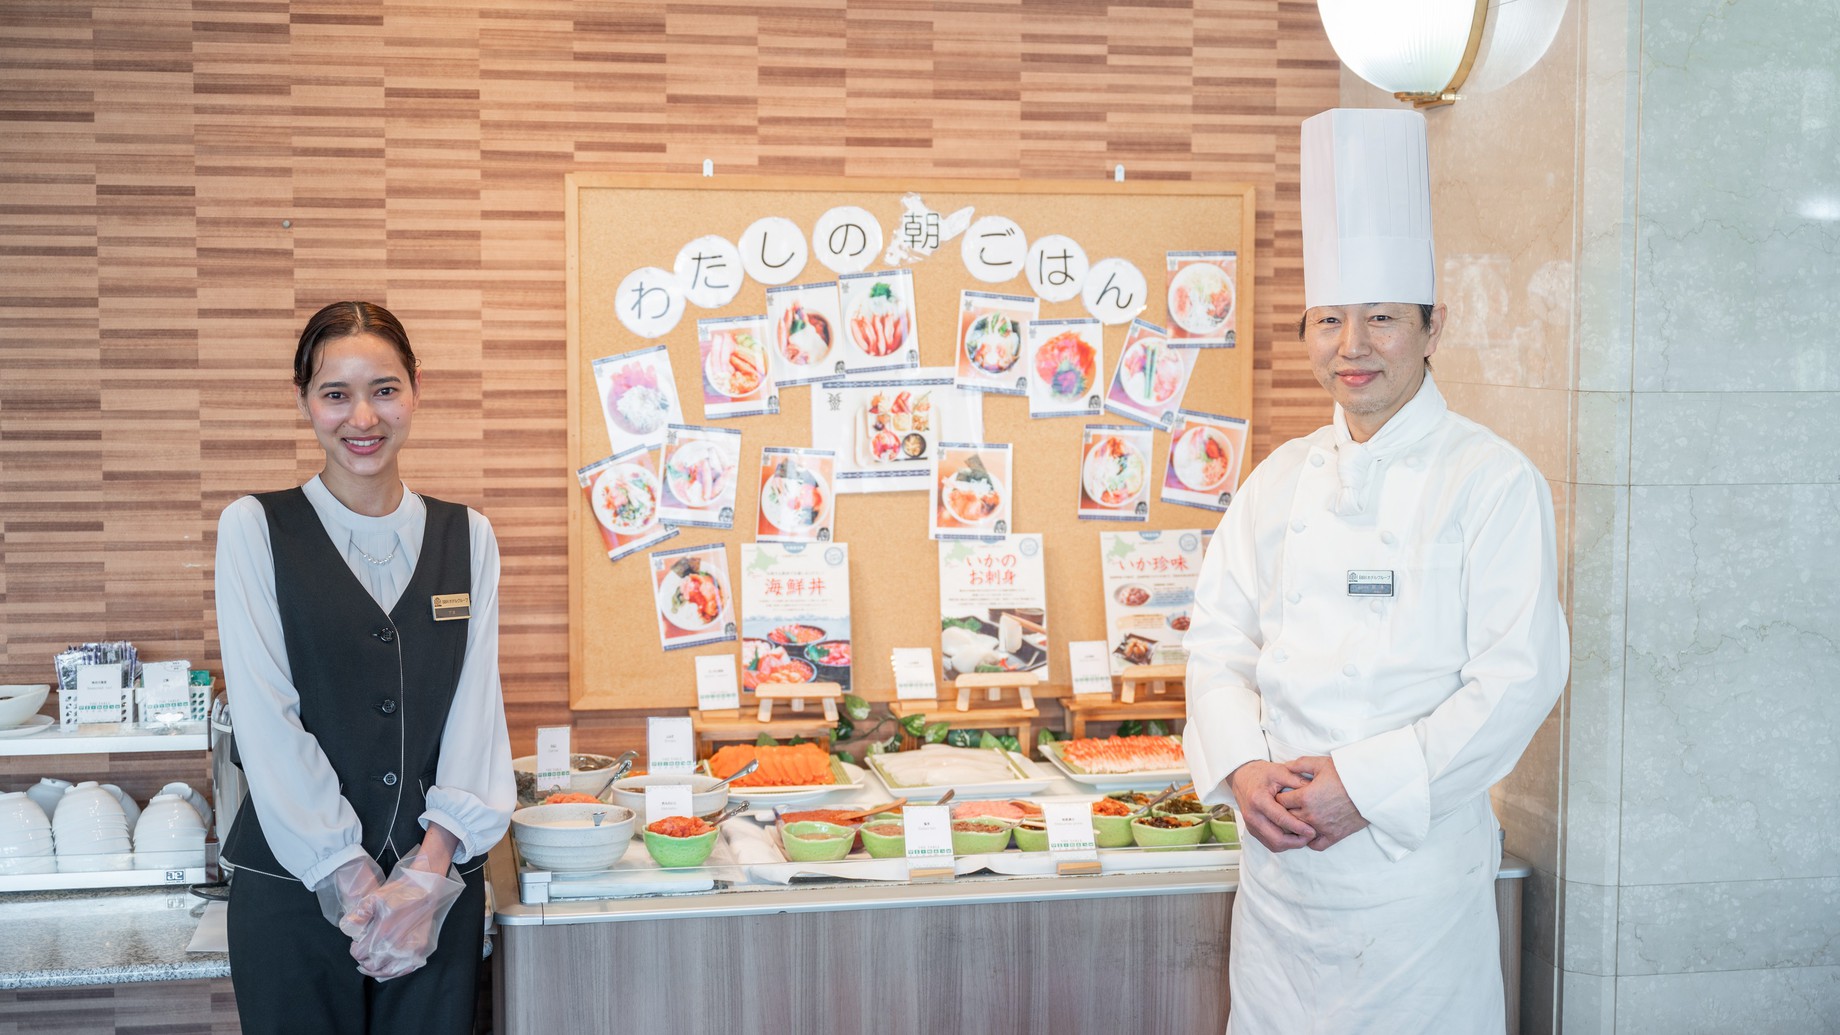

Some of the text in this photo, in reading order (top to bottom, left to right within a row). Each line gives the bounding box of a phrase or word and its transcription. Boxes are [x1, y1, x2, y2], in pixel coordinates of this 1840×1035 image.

[631, 213, 1133, 319] わたしの朝ごはん
[966, 554, 1017, 568] いかの
[1119, 554, 1189, 572] いか珍味
[970, 568, 1015, 585] お刺身
[765, 577, 826, 596] 海鮮丼
